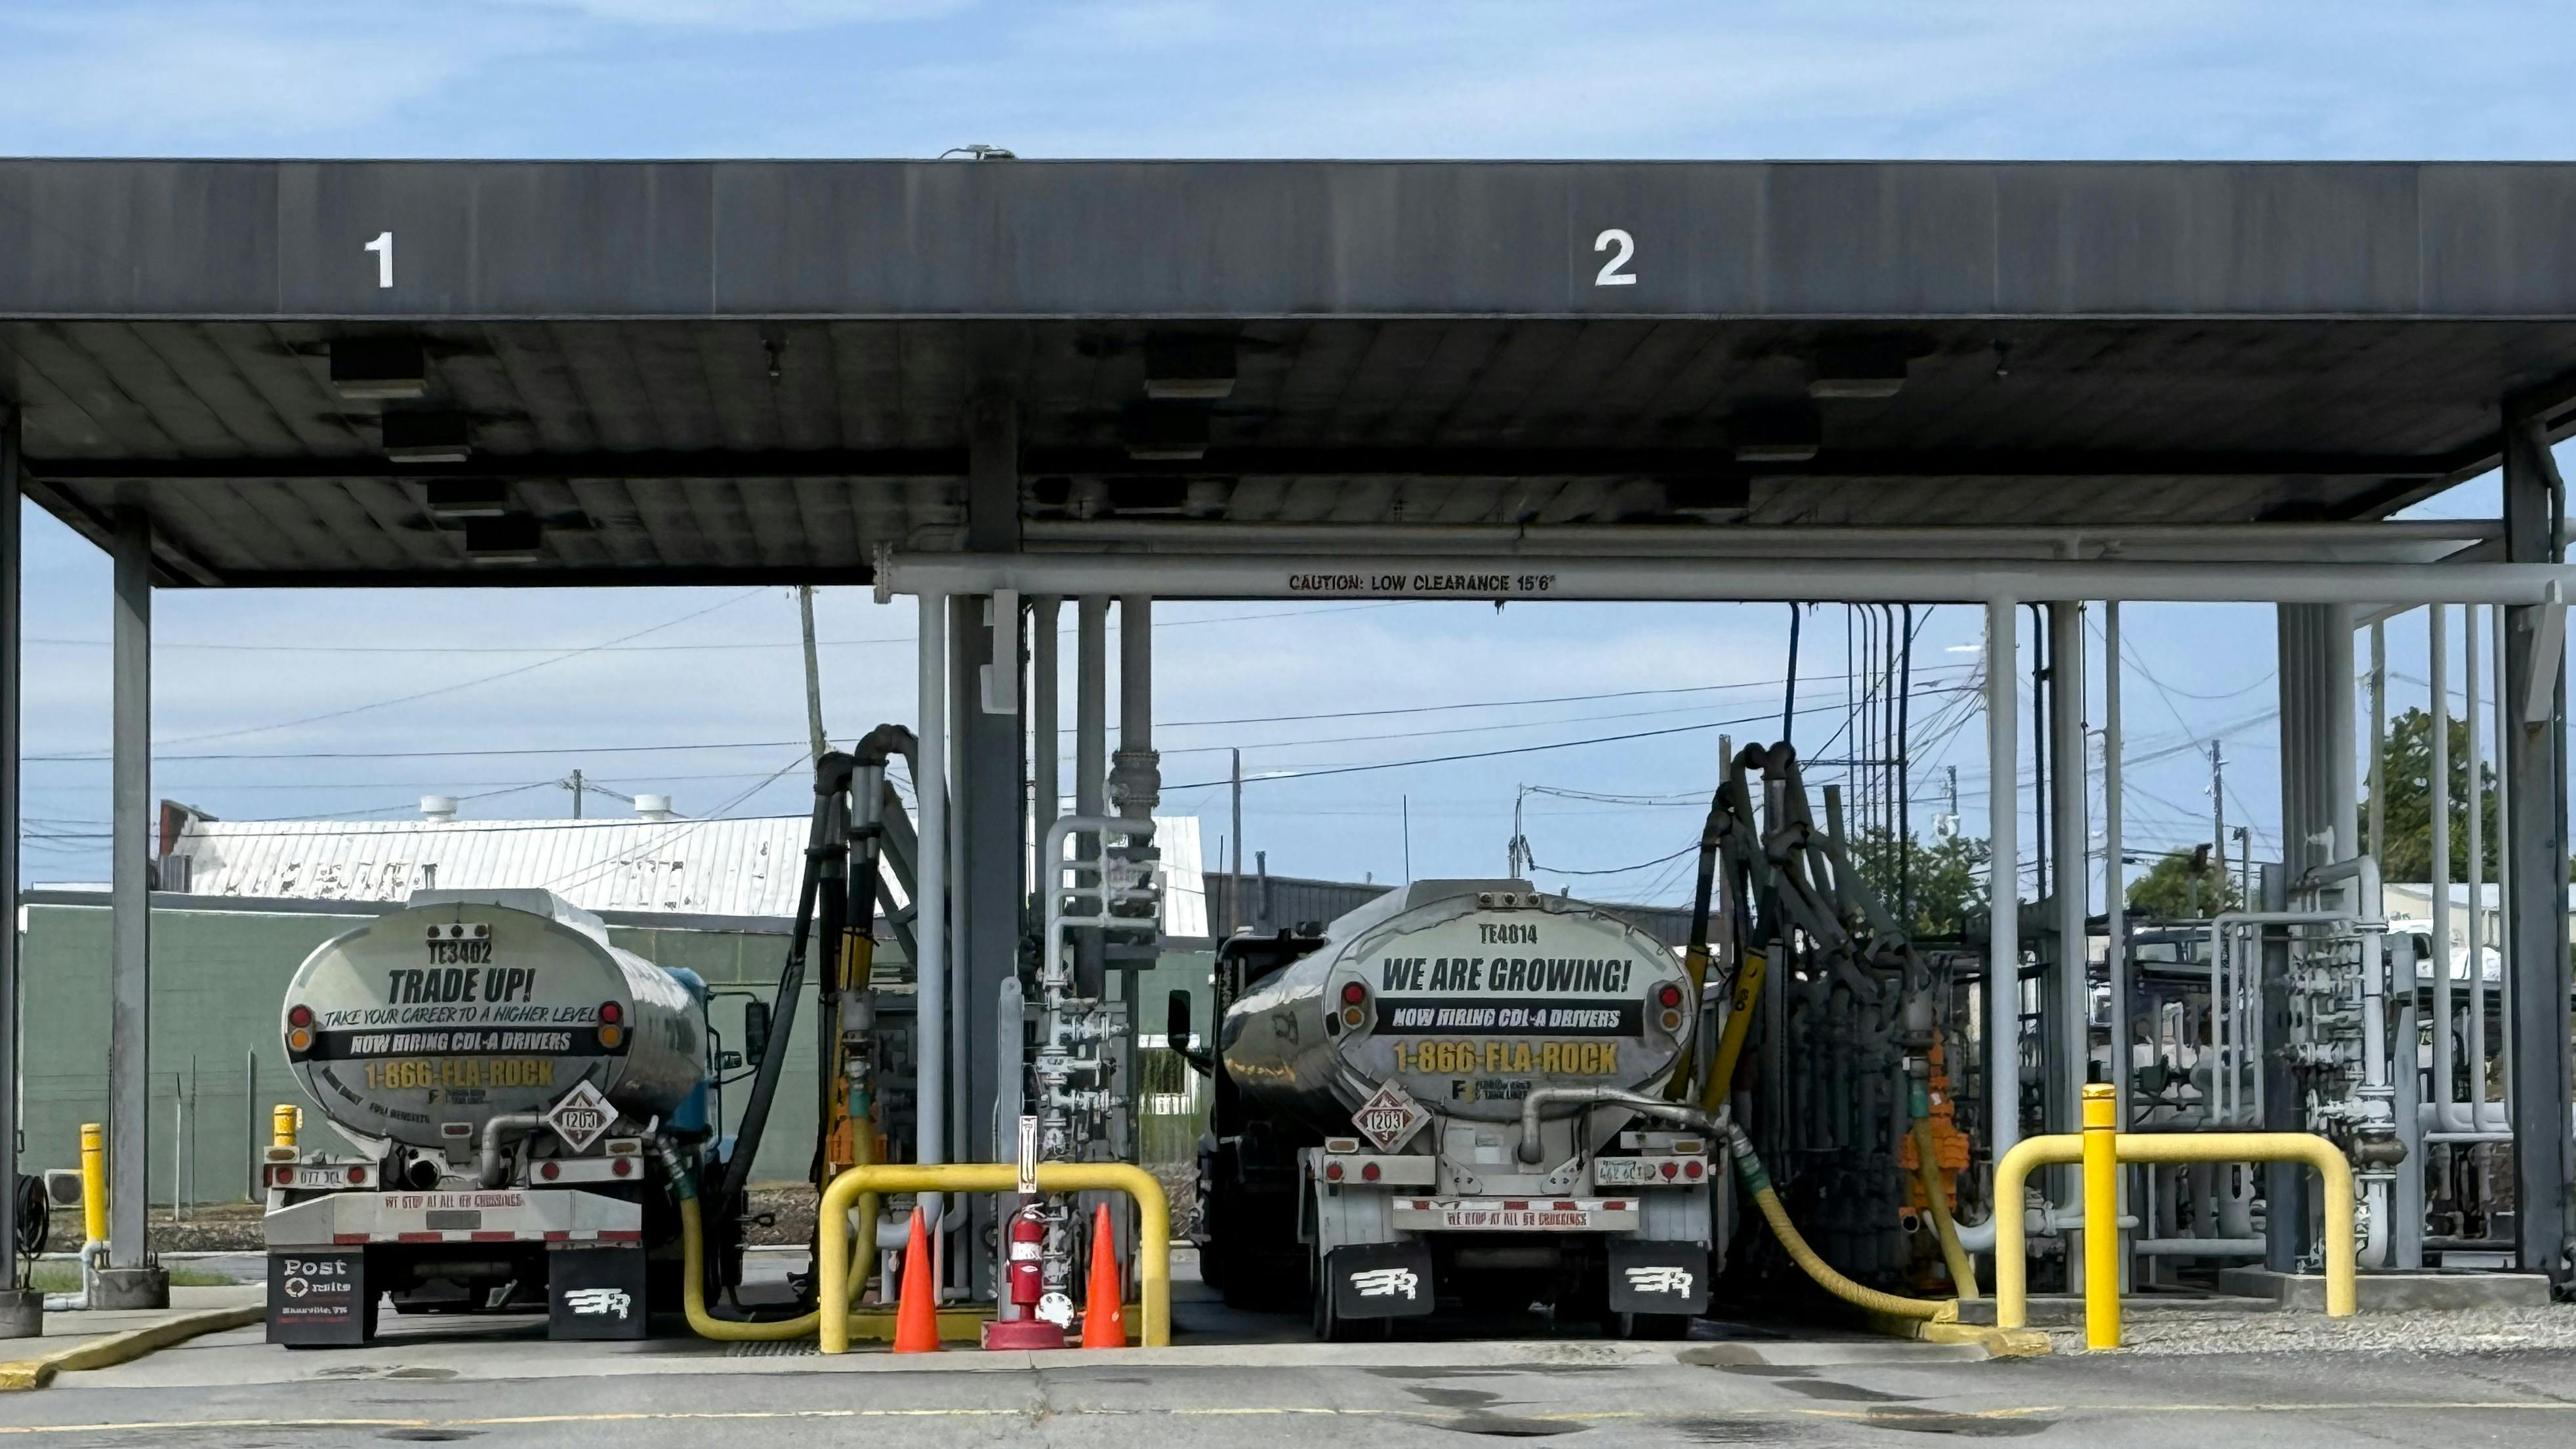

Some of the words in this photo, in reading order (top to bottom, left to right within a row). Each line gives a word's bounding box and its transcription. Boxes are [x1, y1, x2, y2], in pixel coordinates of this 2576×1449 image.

[364, 231, 393, 288] 1
[1595, 229, 1637, 286] 2
[1290, 575, 1364, 591] CAUTION:
[1372, 575, 1406, 591] LOW
[1414, 575, 1509, 591] CLEARANCE
[1479, 924, 1538, 945] TE4014
[428, 942, 492, 964] TE3402
[388, 969, 480, 1004] TRADE
[485, 968, 536, 1003] UP!
[1383, 958, 1427, 991] WE
[1429, 958, 1484, 991] ARE
[1488, 958, 1633, 992] GROWING!
[325, 1010, 360, 1027] TAKE
[363, 1009, 398, 1025] YOUR
[401, 1007, 458, 1024] CAREER
[459, 1008, 476, 1023] TO
[480, 1007, 491, 1023] A
[495, 1006, 548, 1024] HIGHER
[552, 1006, 597, 1023] LEVEL
[1393, 1008, 1435, 1027] NOW
[1436, 1008, 1496, 1027] HIRING
[1549, 1009, 1621, 1028] DRIVERS
[350, 1034, 392, 1055] NOW
[392, 1034, 447, 1053] HIRING
[499, 1032, 571, 1051] DRIVERS
[1393, 1040, 1620, 1075] 1-866-FLA-ROCK
[363, 1059, 556, 1090] 1-866-FLA-ROCK
[567, 1112, 596, 1128] 1203
[1371, 1113, 1401, 1129] 1203
